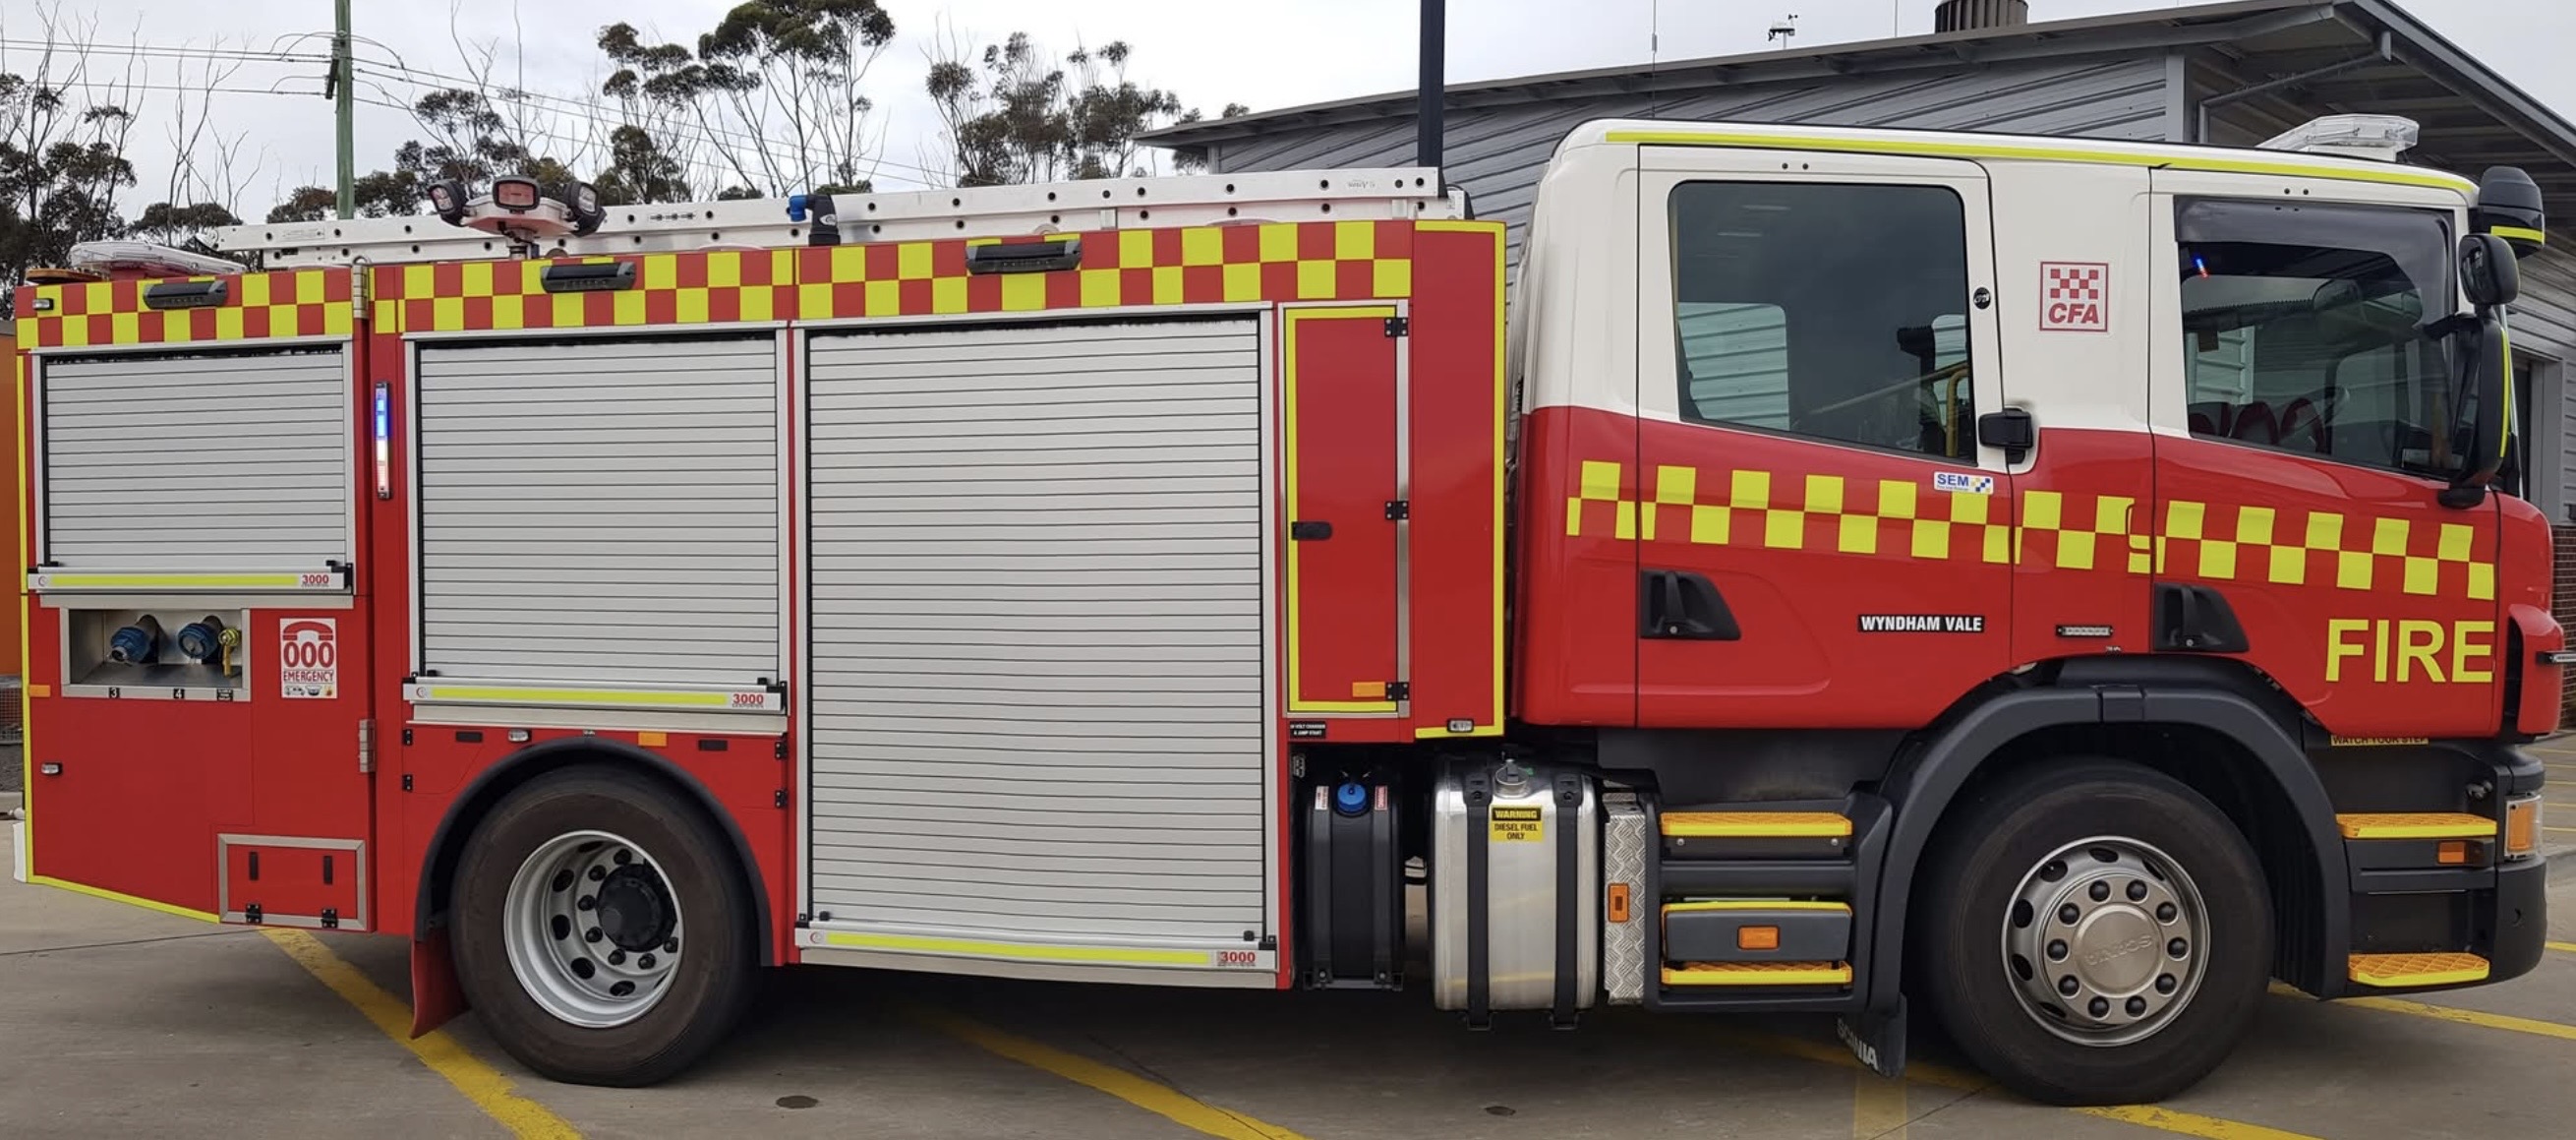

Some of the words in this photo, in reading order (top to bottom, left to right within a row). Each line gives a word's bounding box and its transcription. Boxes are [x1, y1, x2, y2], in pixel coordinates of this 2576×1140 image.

[2048, 302, 2100, 325] CFA
[1937, 473, 1969, 487] SEM
[302, 574, 329, 584] 3000
[1861, 616, 1940, 630] WYNDHAM
[1945, 617, 1983, 631] VALE
[283, 641, 334, 668] 000
[2325, 619, 2495, 683] FIRE
[283, 671, 334, 683] EMERGENCY
[111, 689, 118, 698] 3
[175, 689, 183, 699] 4
[732, 693, 764, 704] 3000
[1494, 810, 1538, 819] WARNING
[1494, 823, 1519, 832] DIESEL
[1521, 823, 1538, 832] FUEL
[1219, 951, 1256, 962] 3000
